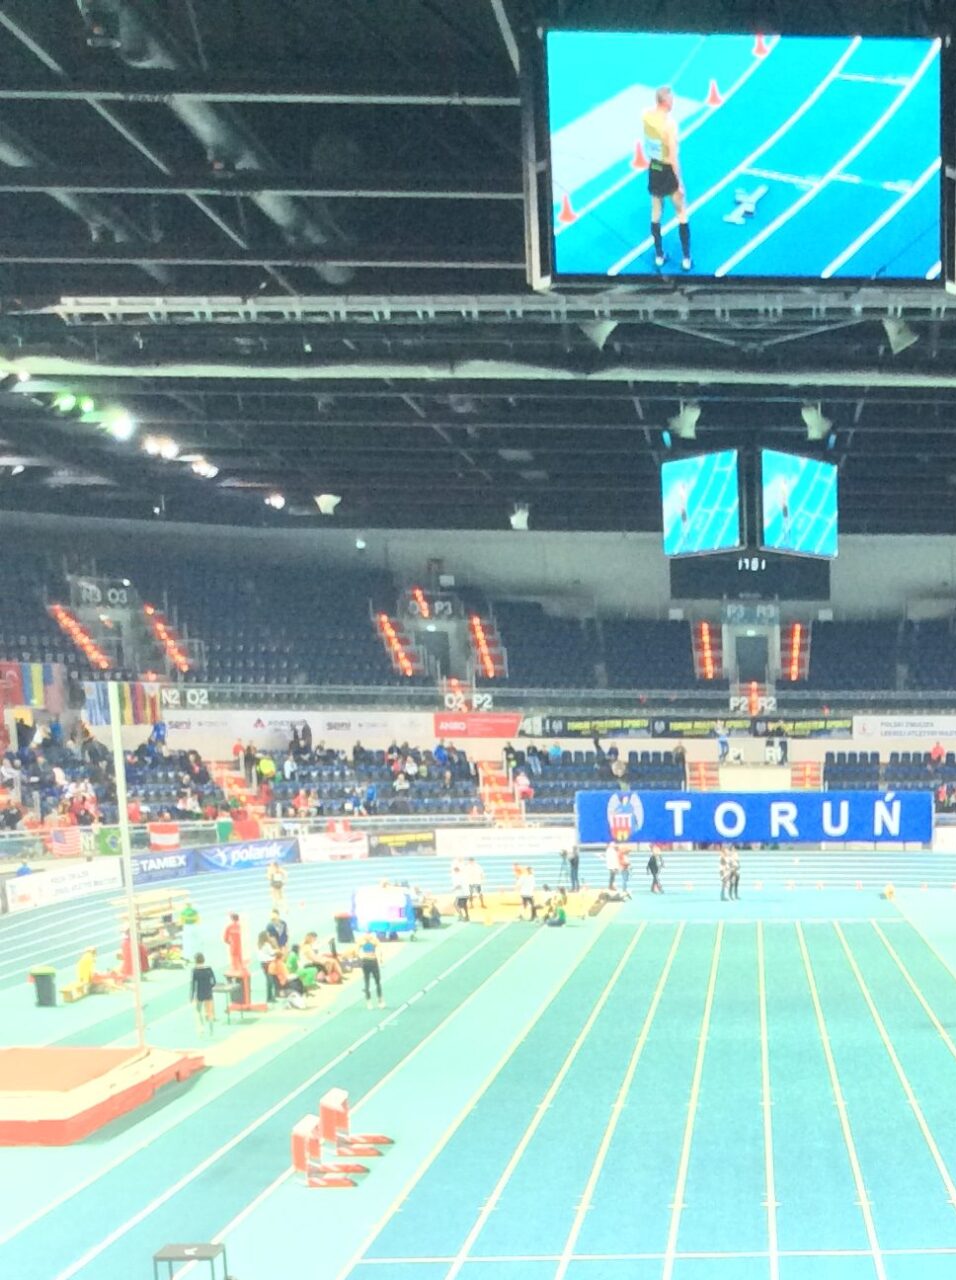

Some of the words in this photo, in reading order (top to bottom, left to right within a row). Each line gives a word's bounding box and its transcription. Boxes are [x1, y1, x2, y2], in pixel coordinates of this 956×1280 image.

[108, 588, 128, 604] O3
[435, 601, 453, 615] P3
[162, 689, 180, 704] N2
[186, 689, 208, 704] O2
[444, 692, 464, 709] O2
[472, 692, 493, 709] P2
[729, 696, 749, 712] P2
[665, 792, 901, 837] TORUŃ
[140, 855, 187, 871] TAMEX
